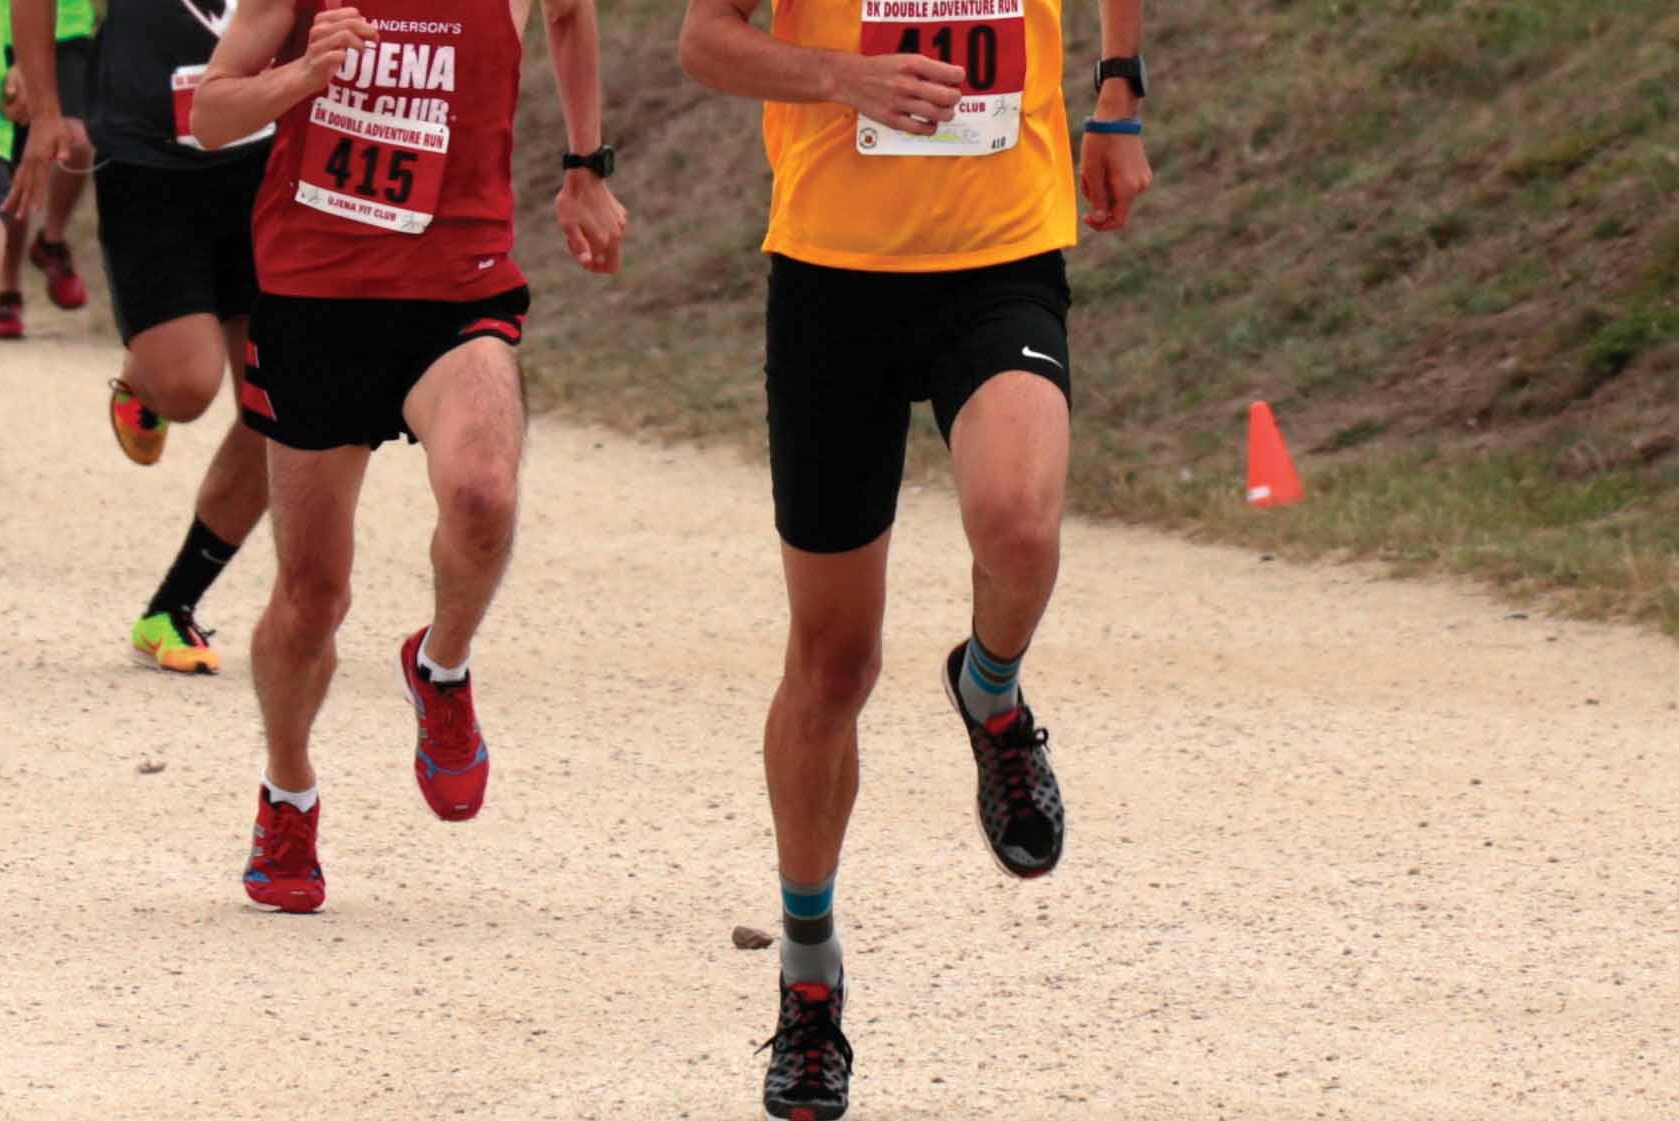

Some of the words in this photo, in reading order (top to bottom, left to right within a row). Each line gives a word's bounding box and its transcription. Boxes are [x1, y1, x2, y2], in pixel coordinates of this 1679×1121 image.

[867, 1, 880, 17] 8K
[884, 1, 928, 18] DOUBLE
[932, 0, 994, 17] ADVENTURE
[959, 102, 986, 113] CLUB
[328, 112, 363, 134] DOUBLE
[366, 123, 421, 146] ADVENTURE
[423, 133, 444, 149] RUN
[325, 137, 418, 204] 415
